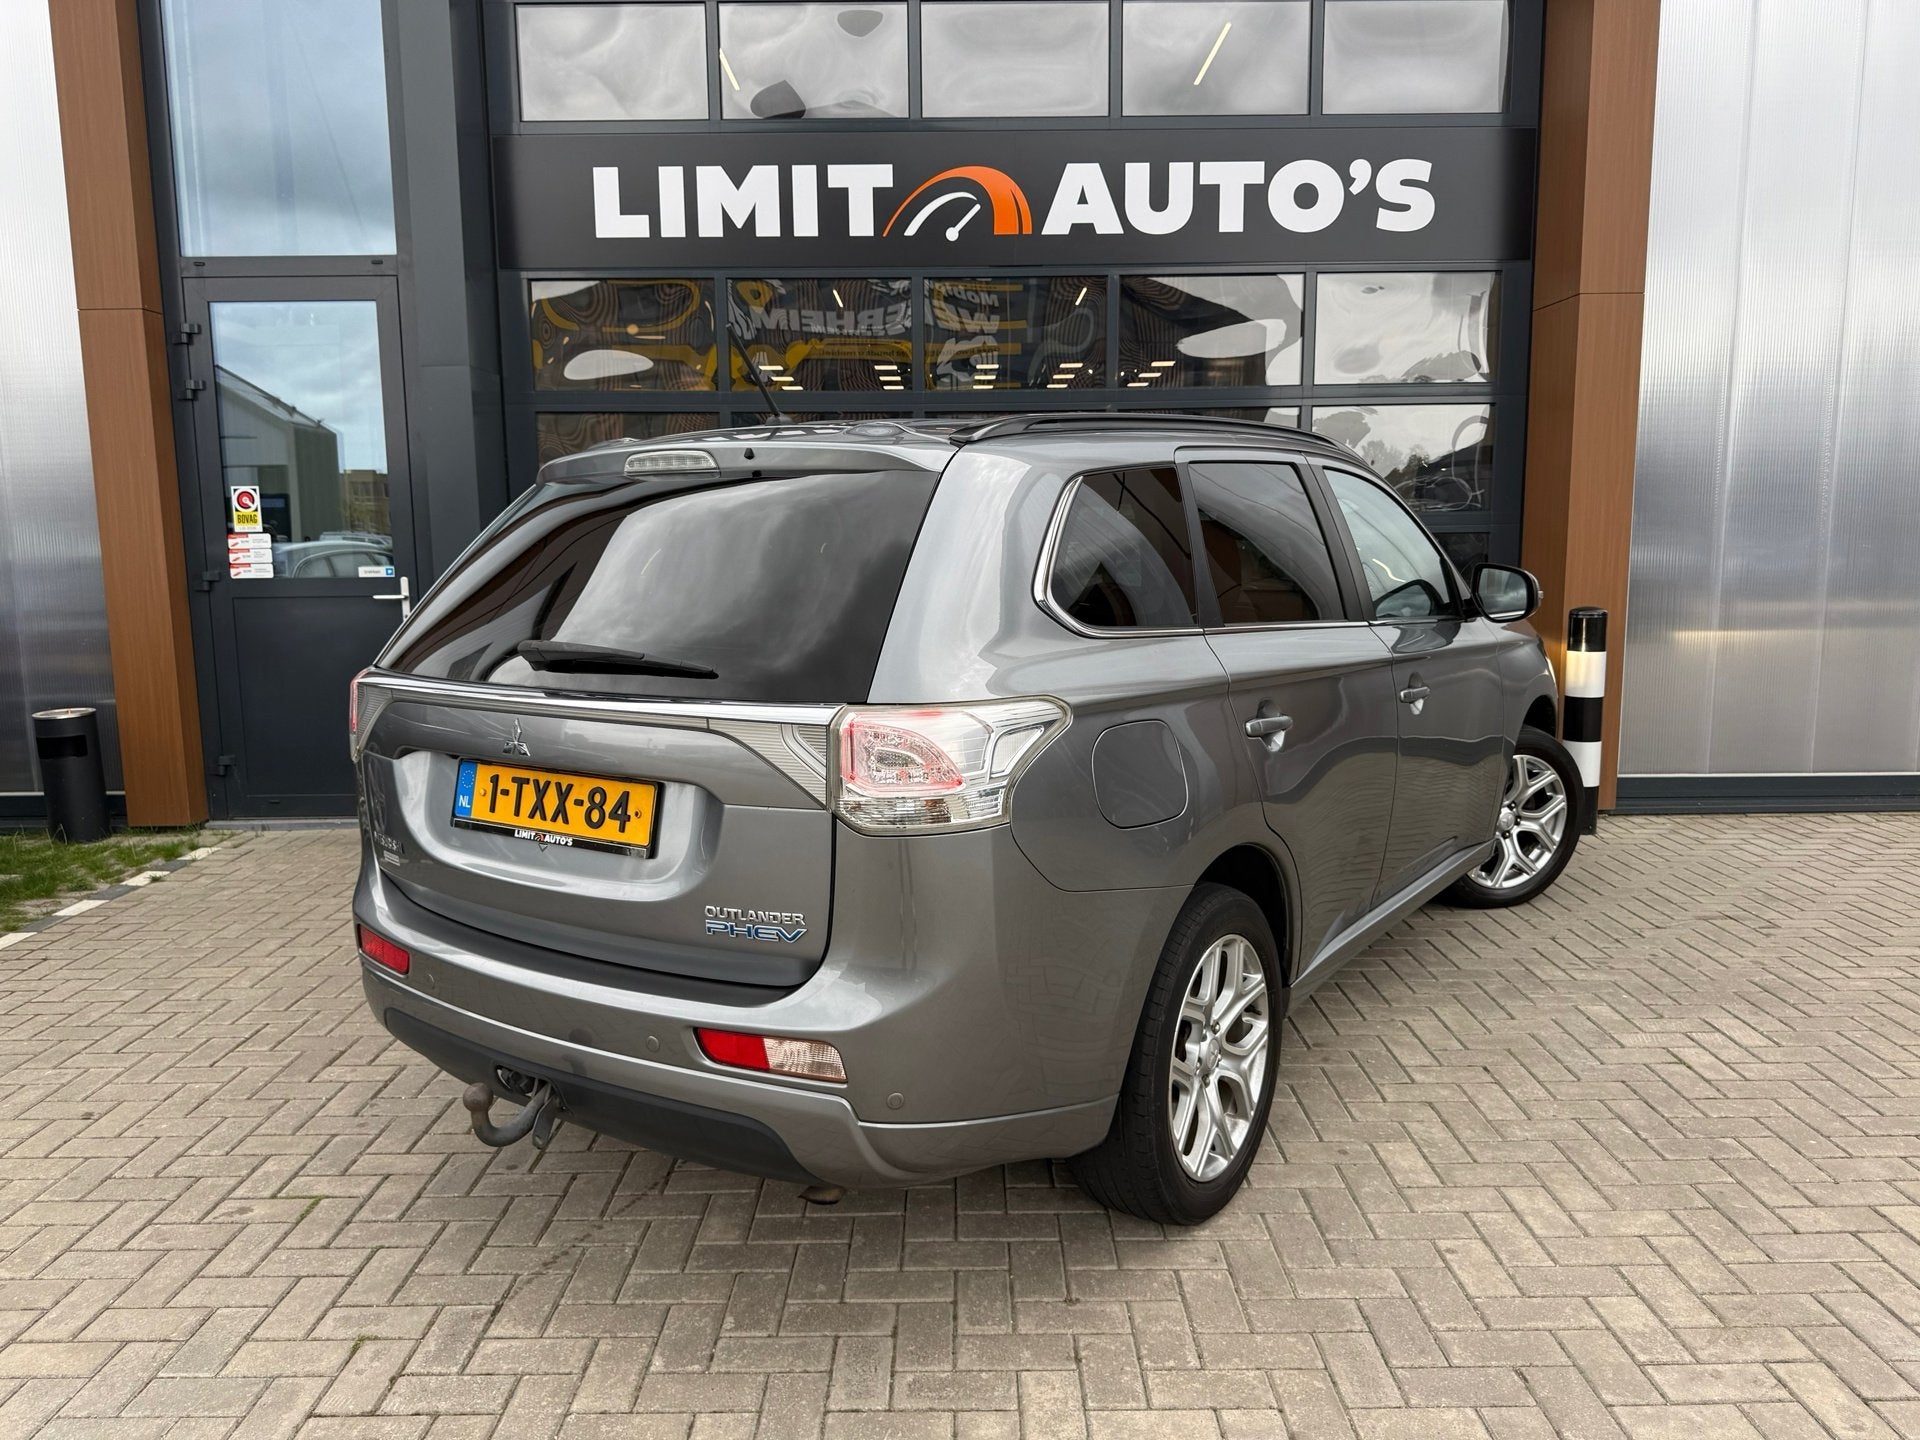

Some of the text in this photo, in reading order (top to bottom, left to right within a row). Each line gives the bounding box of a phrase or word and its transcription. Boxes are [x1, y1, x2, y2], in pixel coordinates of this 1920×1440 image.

[592, 158, 1436, 239] LIMIT AUTO'S
[237, 514, 258, 524] BOVAG
[458, 794, 471, 809] NL
[489, 773, 631, 834] 1-TXX-84
[514, 828, 574, 847] LIMIT AUTO'S
[704, 905, 806, 926] OUTLANDER
[705, 920, 808, 943] PHEV
